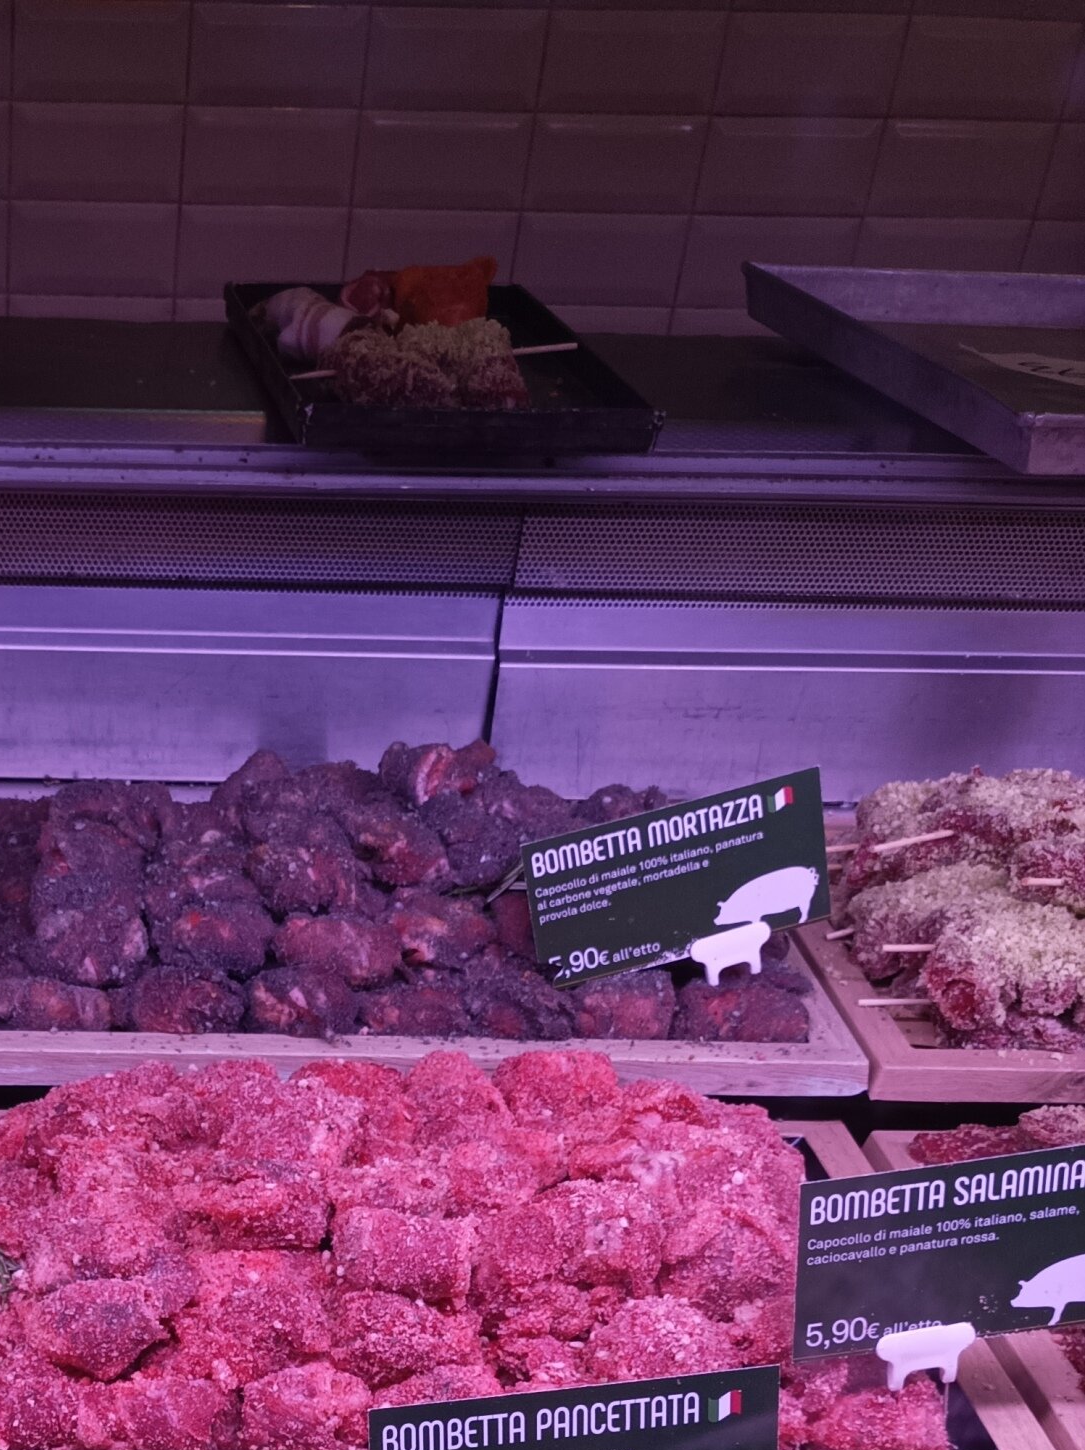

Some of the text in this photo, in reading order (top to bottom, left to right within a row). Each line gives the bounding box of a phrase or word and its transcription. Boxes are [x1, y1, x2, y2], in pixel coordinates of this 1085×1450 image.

[531, 794, 764, 878] BOMBETTA MORTAZZA
[535, 831, 764, 898] Capocollo di maiale 100% italiano, panatura
[537, 900, 547, 911] al
[549, 890, 591, 908] carbone
[643, 860, 700, 883] mortadella
[702, 859, 709, 868] e
[539, 899, 612, 926] provola dolce.
[612, 942, 660, 963] all'etto
[810, 1160, 1085, 1225] BOMBETTA SALAMINA
[806, 1231, 1000, 1266] caciocavallo e panatura rossa.
[807, 1205, 1080, 1250] Capocollo di maiale 100% italiano, salame,
[536, 1391, 700, 1440] PANCETTATA
